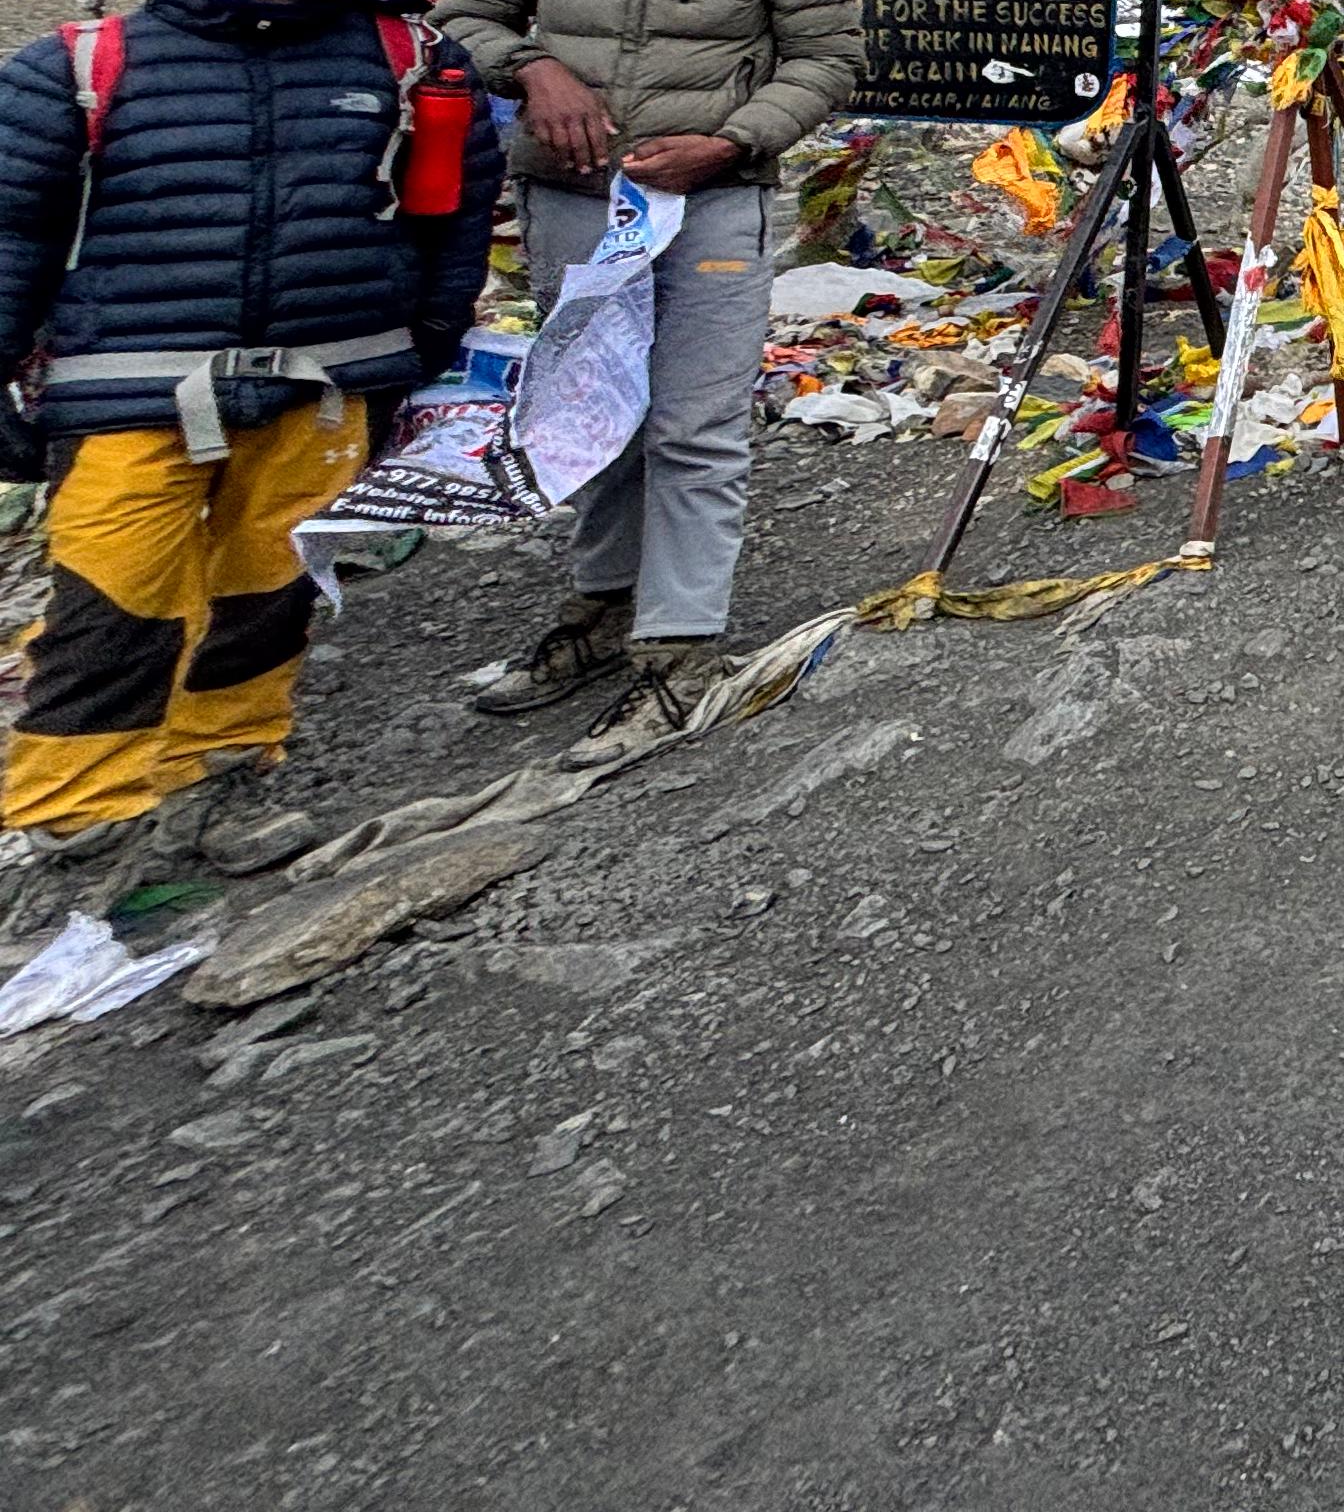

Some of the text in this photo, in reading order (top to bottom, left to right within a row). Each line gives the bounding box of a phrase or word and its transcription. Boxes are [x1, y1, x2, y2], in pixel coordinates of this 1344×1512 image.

[995, 0, 1107, 29] SUCCESS
[900, 28, 961, 52] TREK
[968, 31, 994, 54] IN
[1001, 32, 1099, 59] MANANG
[889, 60, 977, 83] AGAIN
